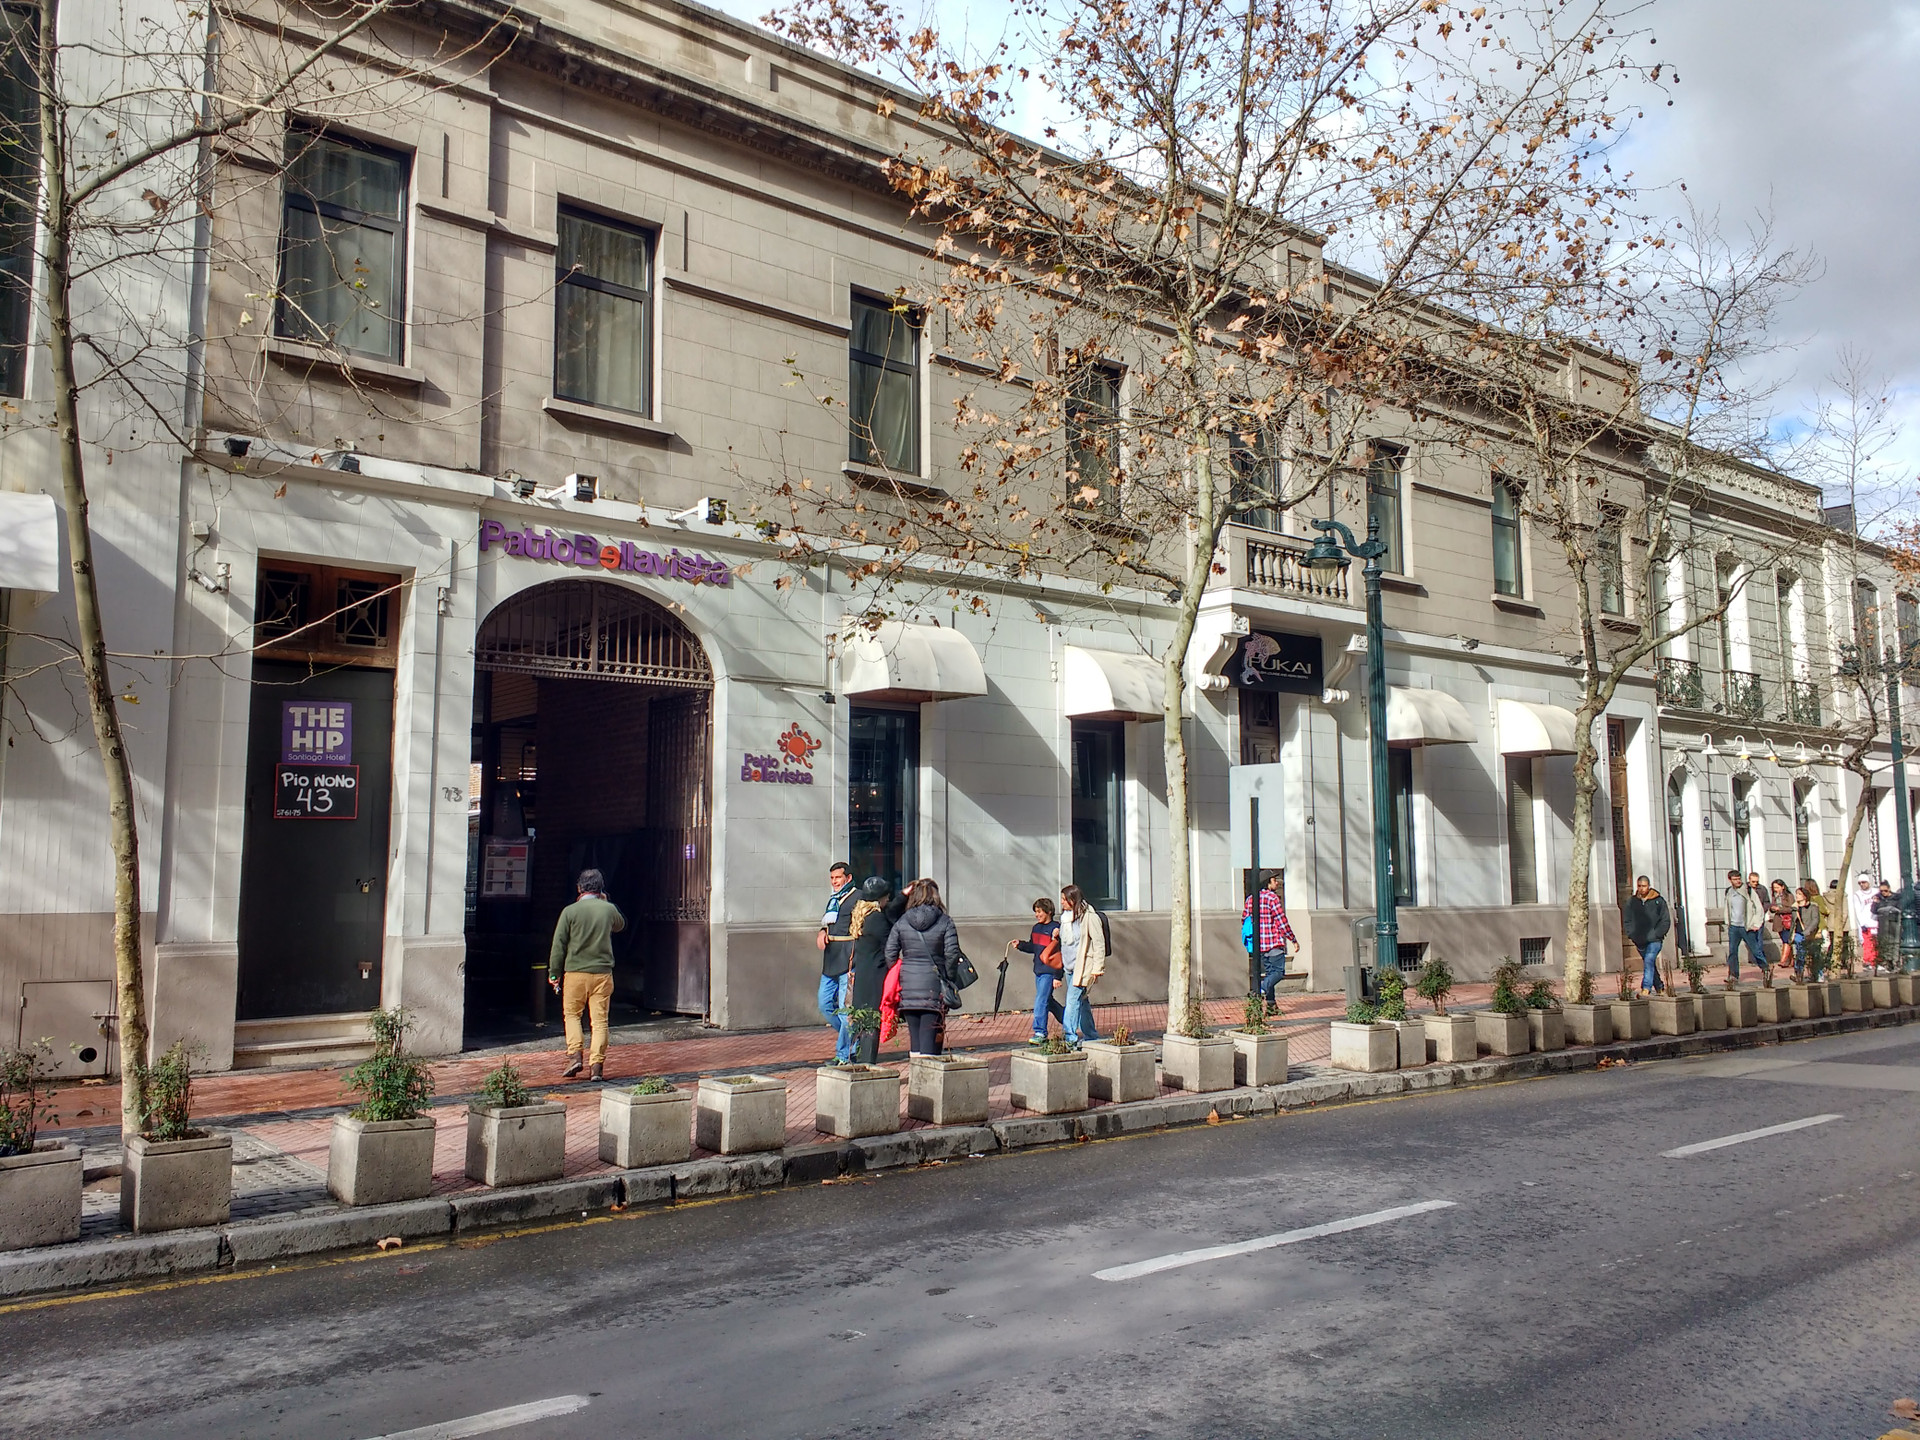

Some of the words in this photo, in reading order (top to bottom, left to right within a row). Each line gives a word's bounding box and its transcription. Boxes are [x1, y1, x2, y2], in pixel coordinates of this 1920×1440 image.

[289, 707, 345, 728] THE
[288, 753, 323, 762] Santiago
[744, 753, 779, 769] Patio
[741, 766, 813, 785] Bellavista
[296, 788, 333, 812] 43
